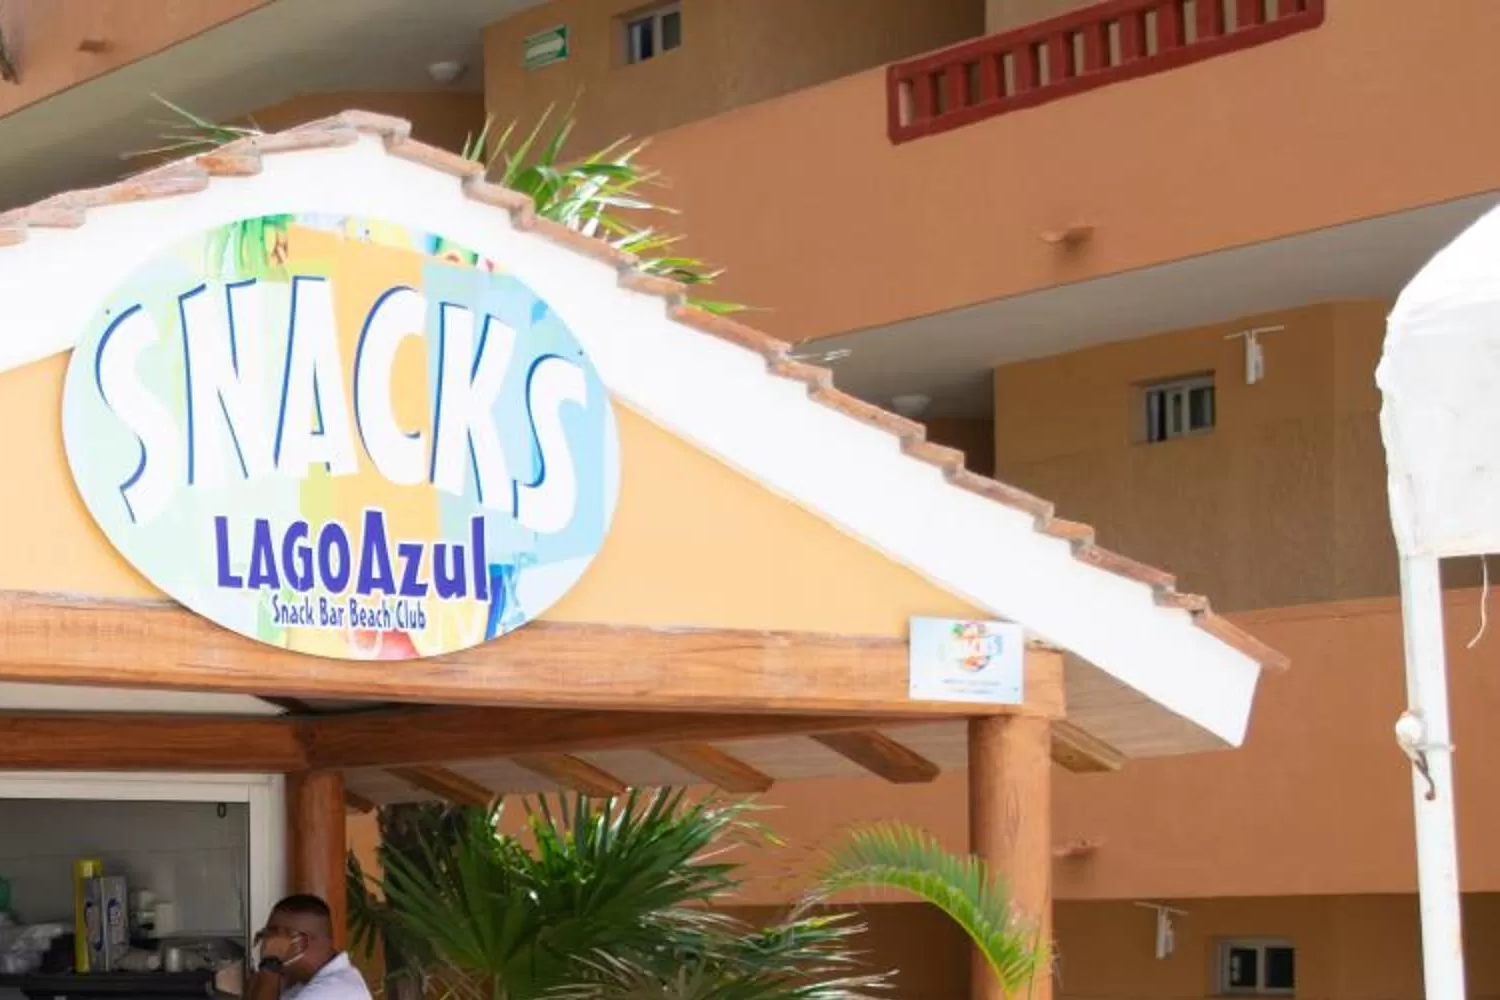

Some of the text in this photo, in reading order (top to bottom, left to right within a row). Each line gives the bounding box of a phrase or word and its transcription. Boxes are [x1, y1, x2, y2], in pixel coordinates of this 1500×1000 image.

[94, 275, 588, 535] SNACKS
[272, 594, 426, 630] Snack Bar Beach Club
